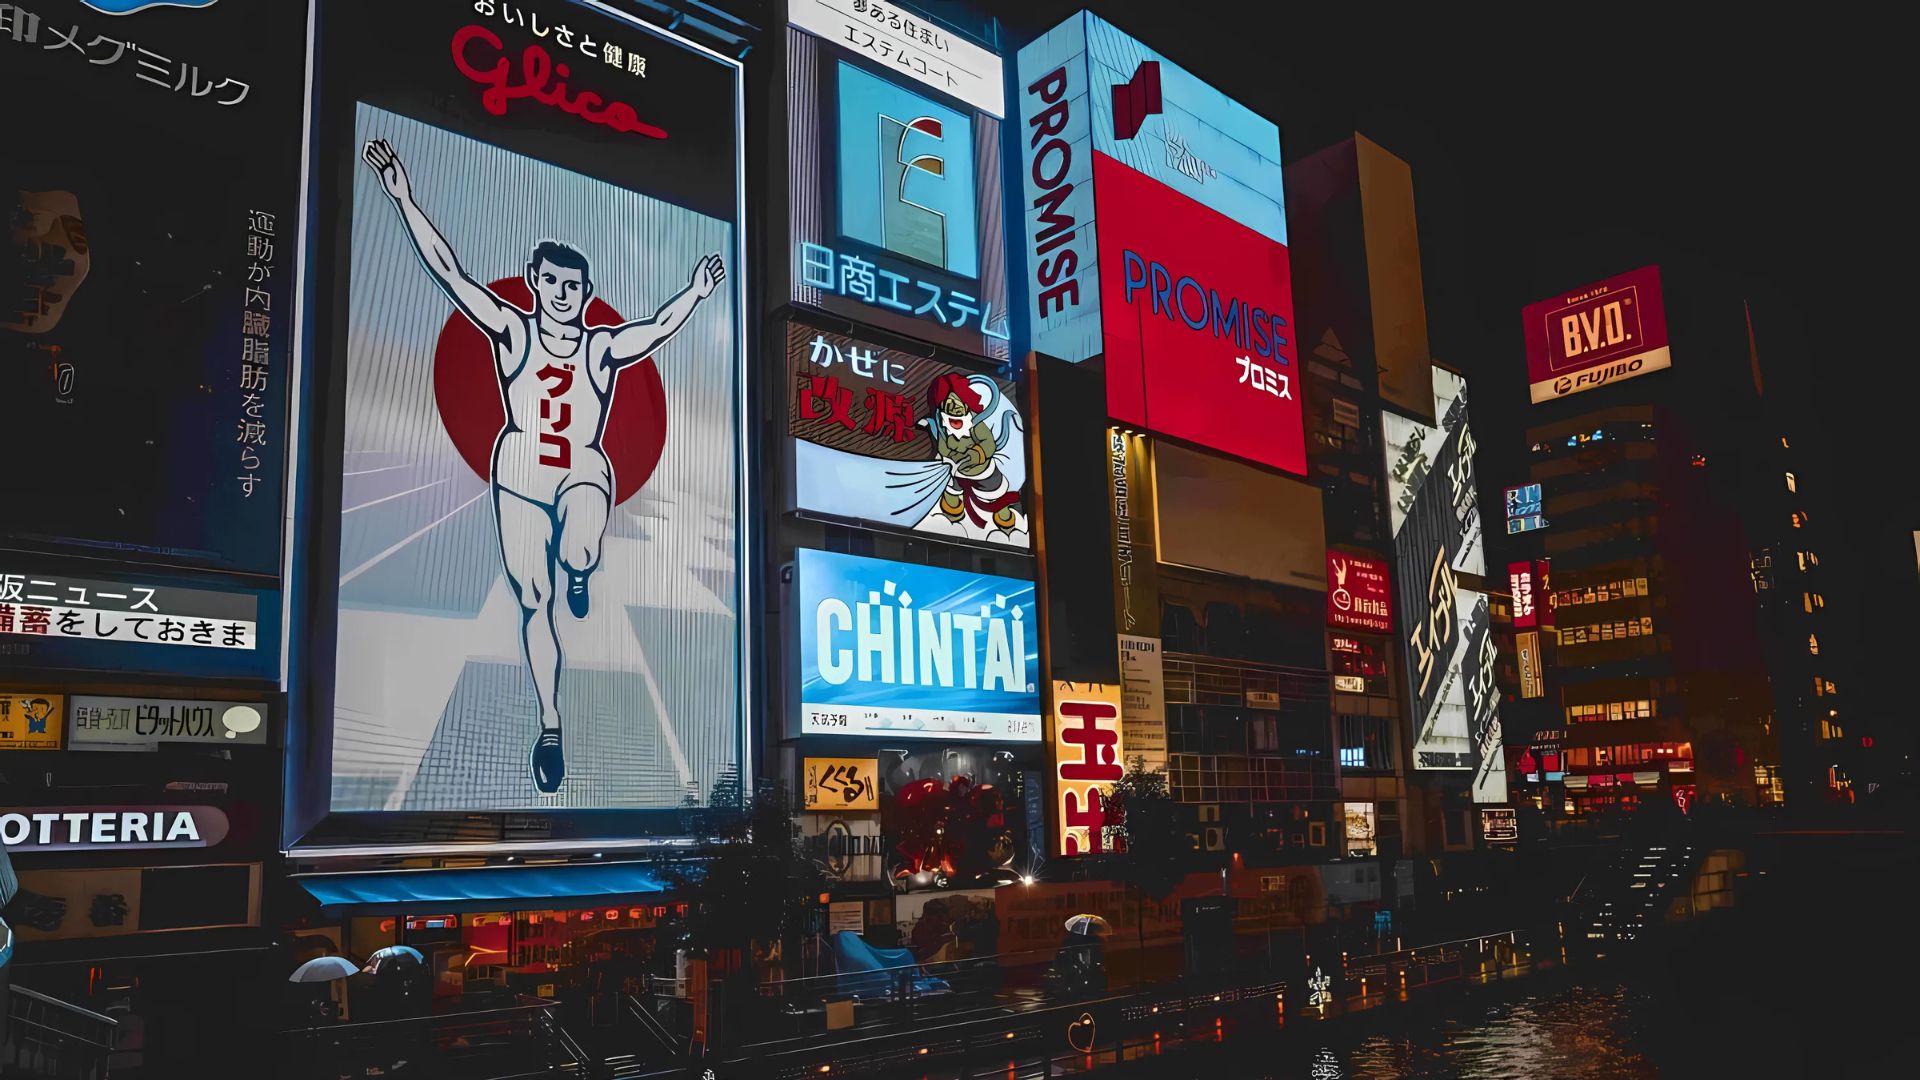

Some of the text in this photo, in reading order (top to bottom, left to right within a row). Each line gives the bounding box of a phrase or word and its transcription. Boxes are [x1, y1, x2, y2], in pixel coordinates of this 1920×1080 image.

[452, 25, 669, 139] Glico
[844, 25, 958, 87] エステムコート
[1028, 66, 1080, 319] PROMISE
[800, 242, 1011, 341] 日商エステム
[1123, 249, 1290, 366] PROMISE
[1561, 301, 1633, 358] B.V.D.
[809, 335, 906, 385] かぜに
[1235, 355, 1293, 401] プロミス
[1575, 358, 1643, 388] FUJIBO
[536, 363, 576, 470] グリコ
[816, 586, 1027, 693] CHINTAI
